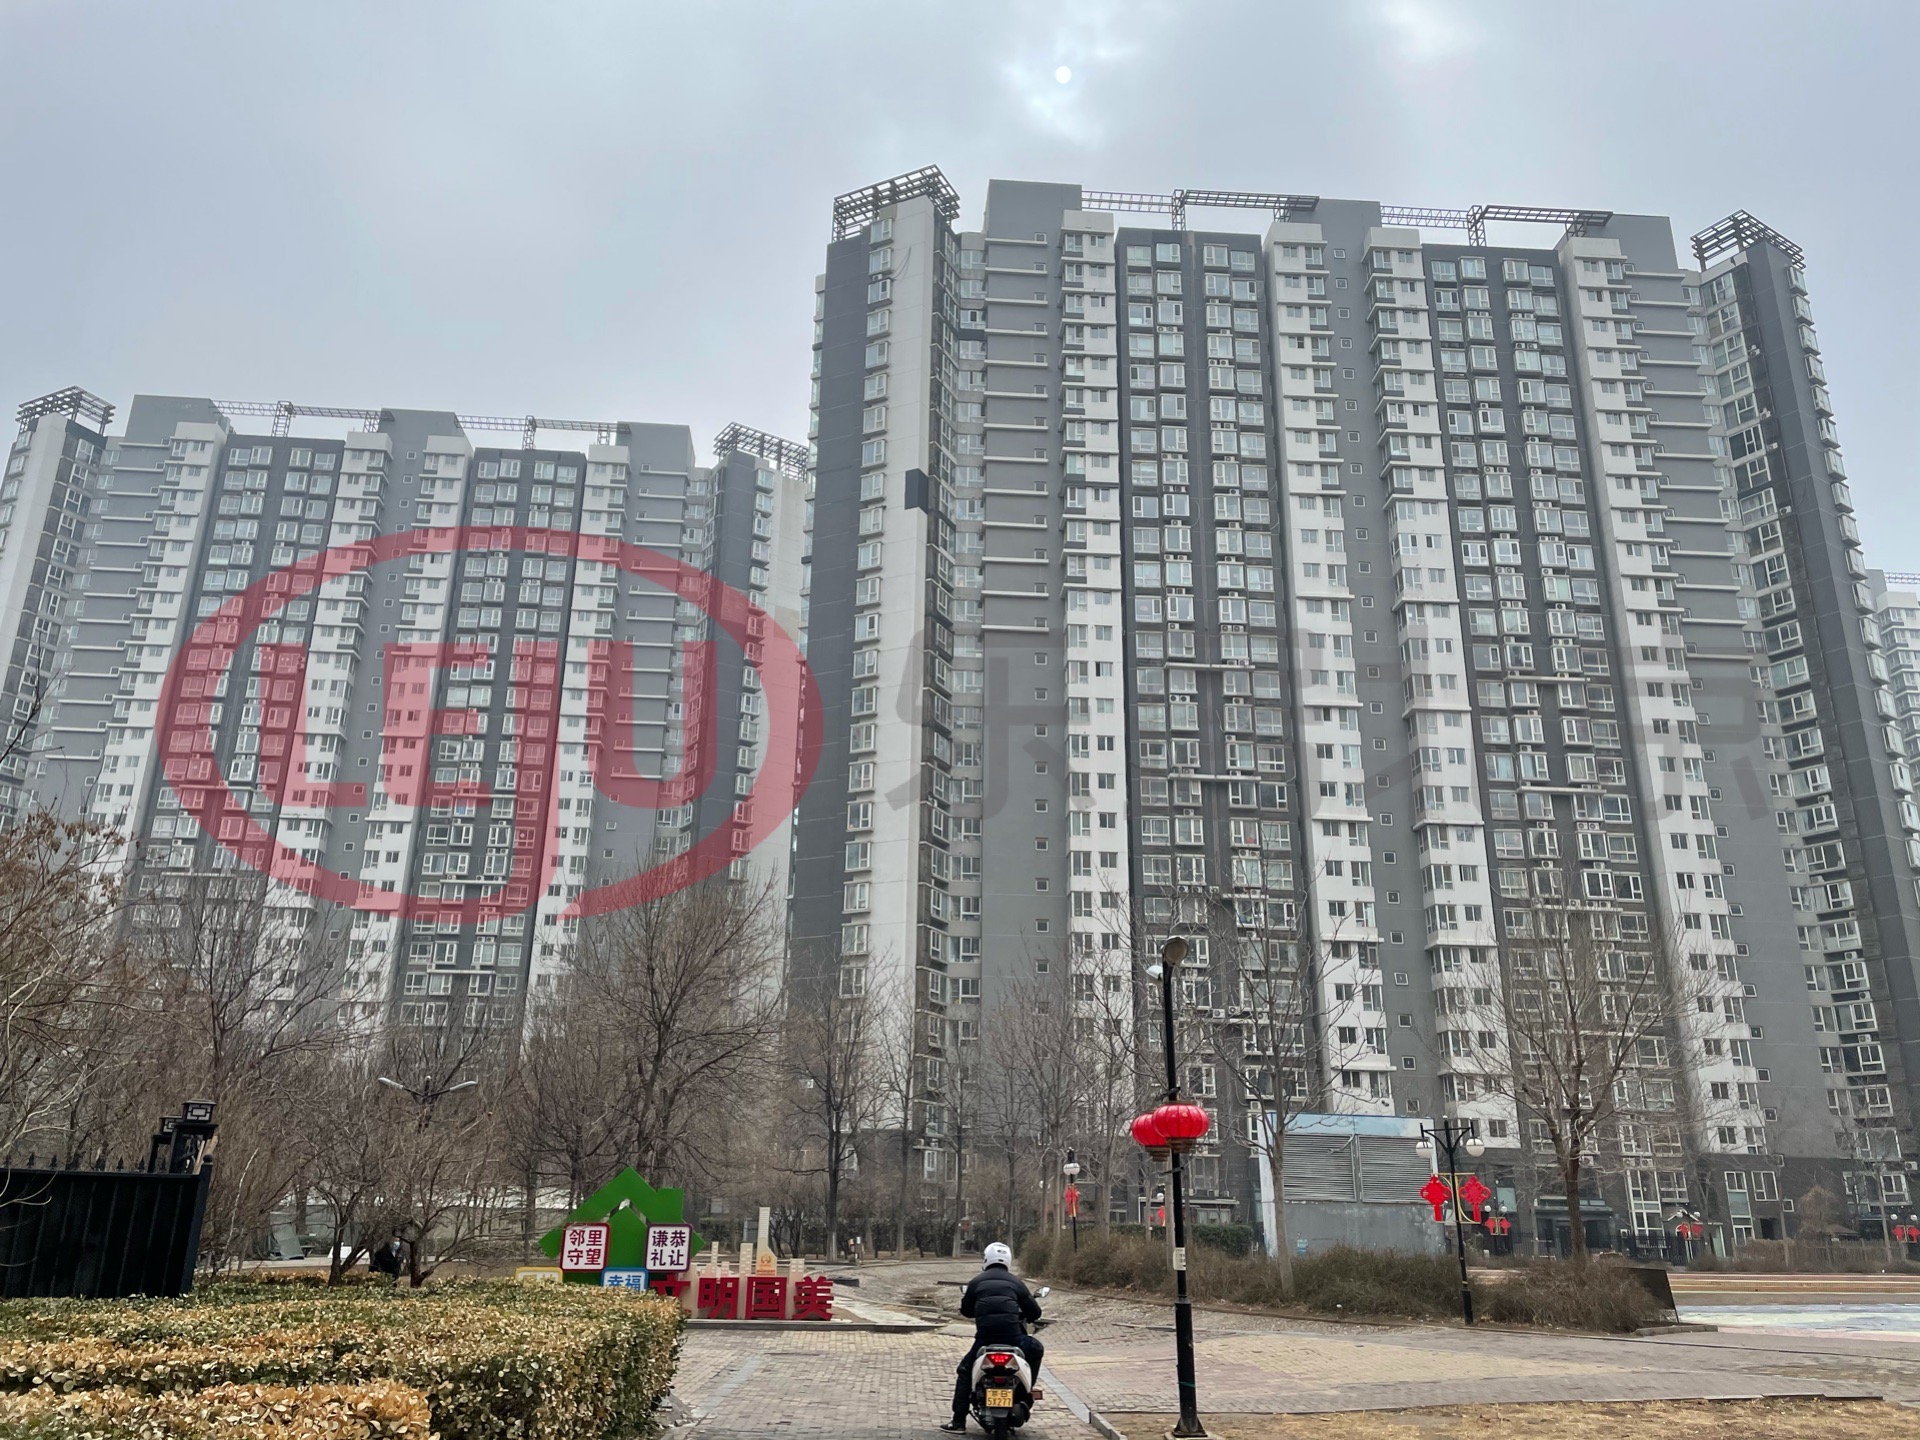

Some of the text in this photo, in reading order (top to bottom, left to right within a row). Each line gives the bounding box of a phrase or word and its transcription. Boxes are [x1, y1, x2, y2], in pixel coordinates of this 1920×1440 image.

[569, 1229, 602, 1247] 邻里
[652, 1230, 686, 1248] 谦恭
[567, 1248, 602, 1266] 守望
[650, 1249, 685, 1267] 礼让
[607, 1274, 642, 1293] 幸福
